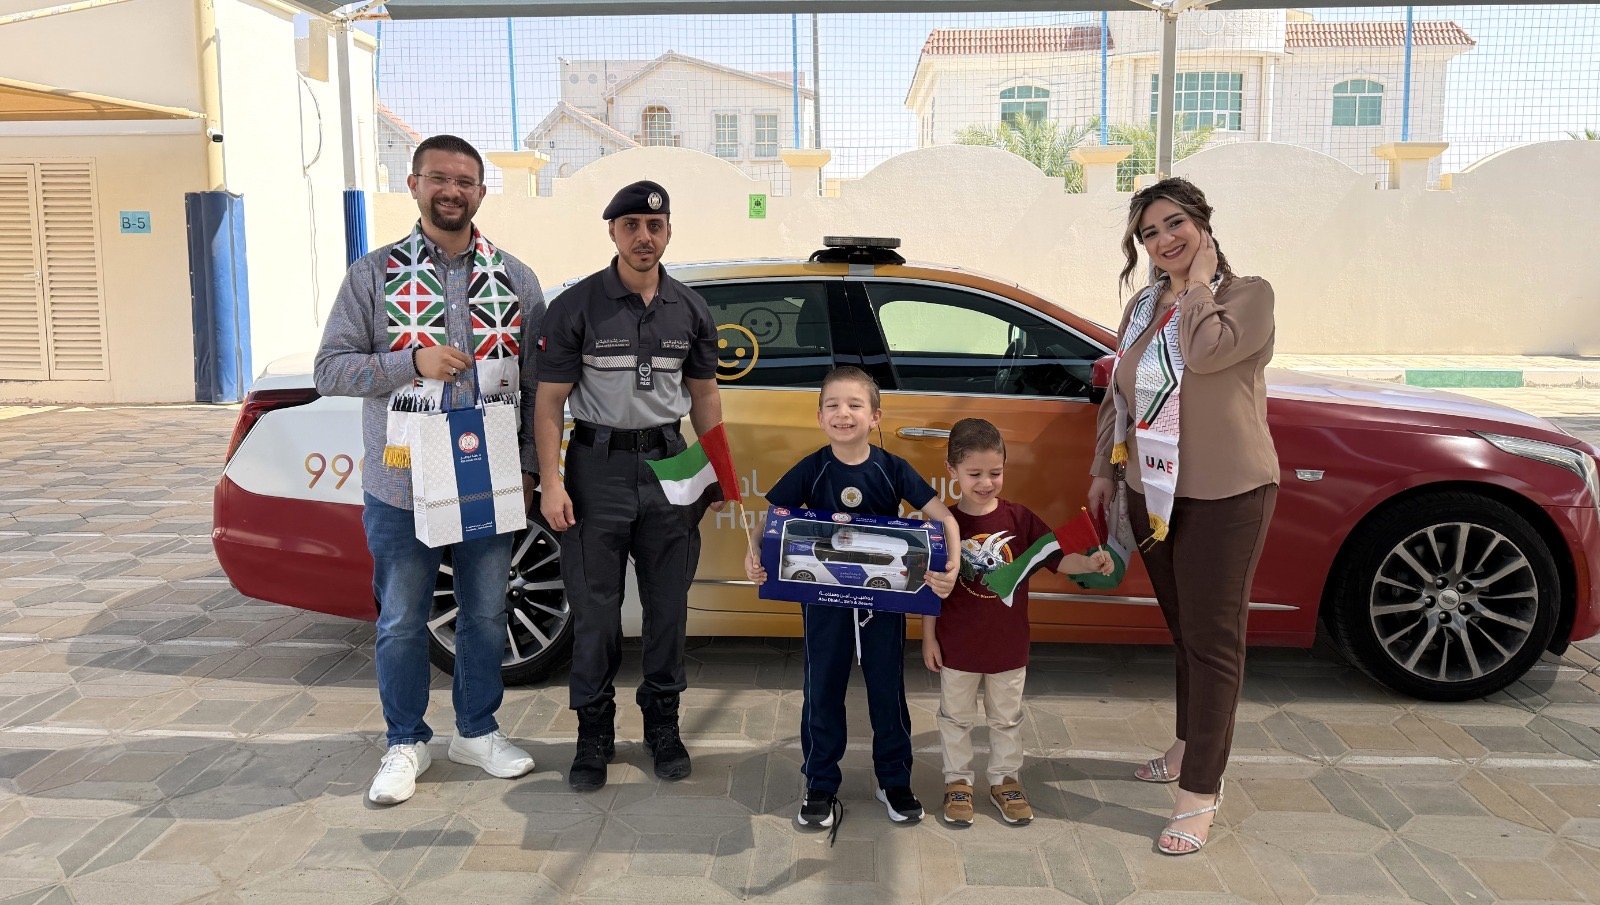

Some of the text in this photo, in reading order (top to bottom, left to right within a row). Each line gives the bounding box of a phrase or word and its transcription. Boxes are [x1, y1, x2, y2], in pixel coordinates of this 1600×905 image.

[122, 217, 146, 229] B-5
[304, 452, 364, 490] 99
[1145, 455, 1174, 475] UAE
